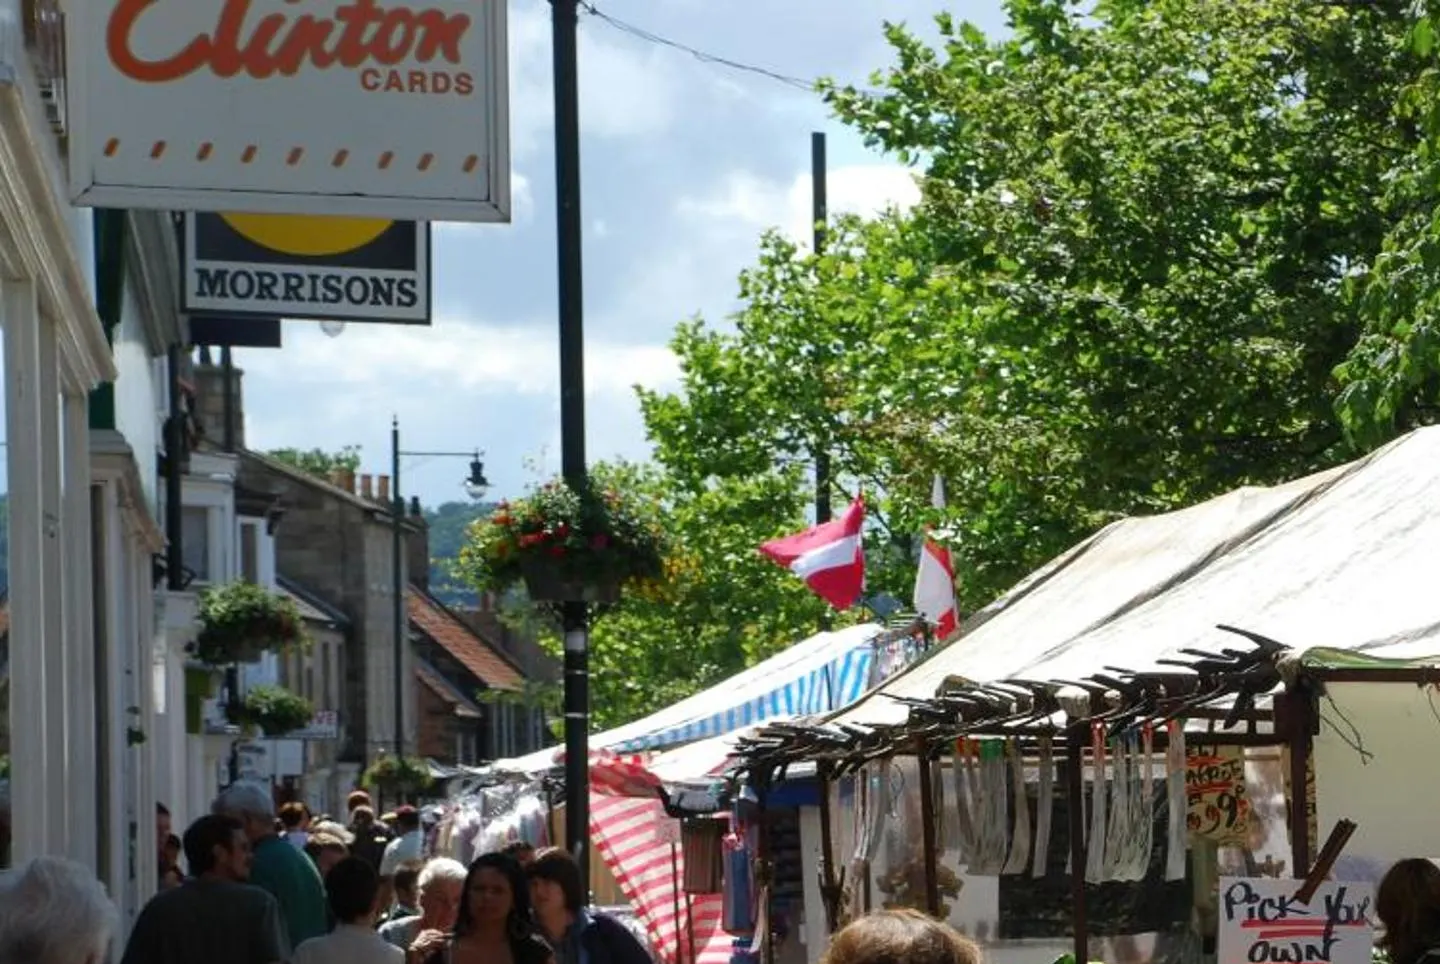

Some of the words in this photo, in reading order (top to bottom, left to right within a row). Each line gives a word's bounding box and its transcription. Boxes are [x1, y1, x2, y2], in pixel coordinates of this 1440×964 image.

[106, 0, 471, 82] Clinton
[360, 69, 475, 95] CARDS
[195, 267, 418, 308] MORRISONS
